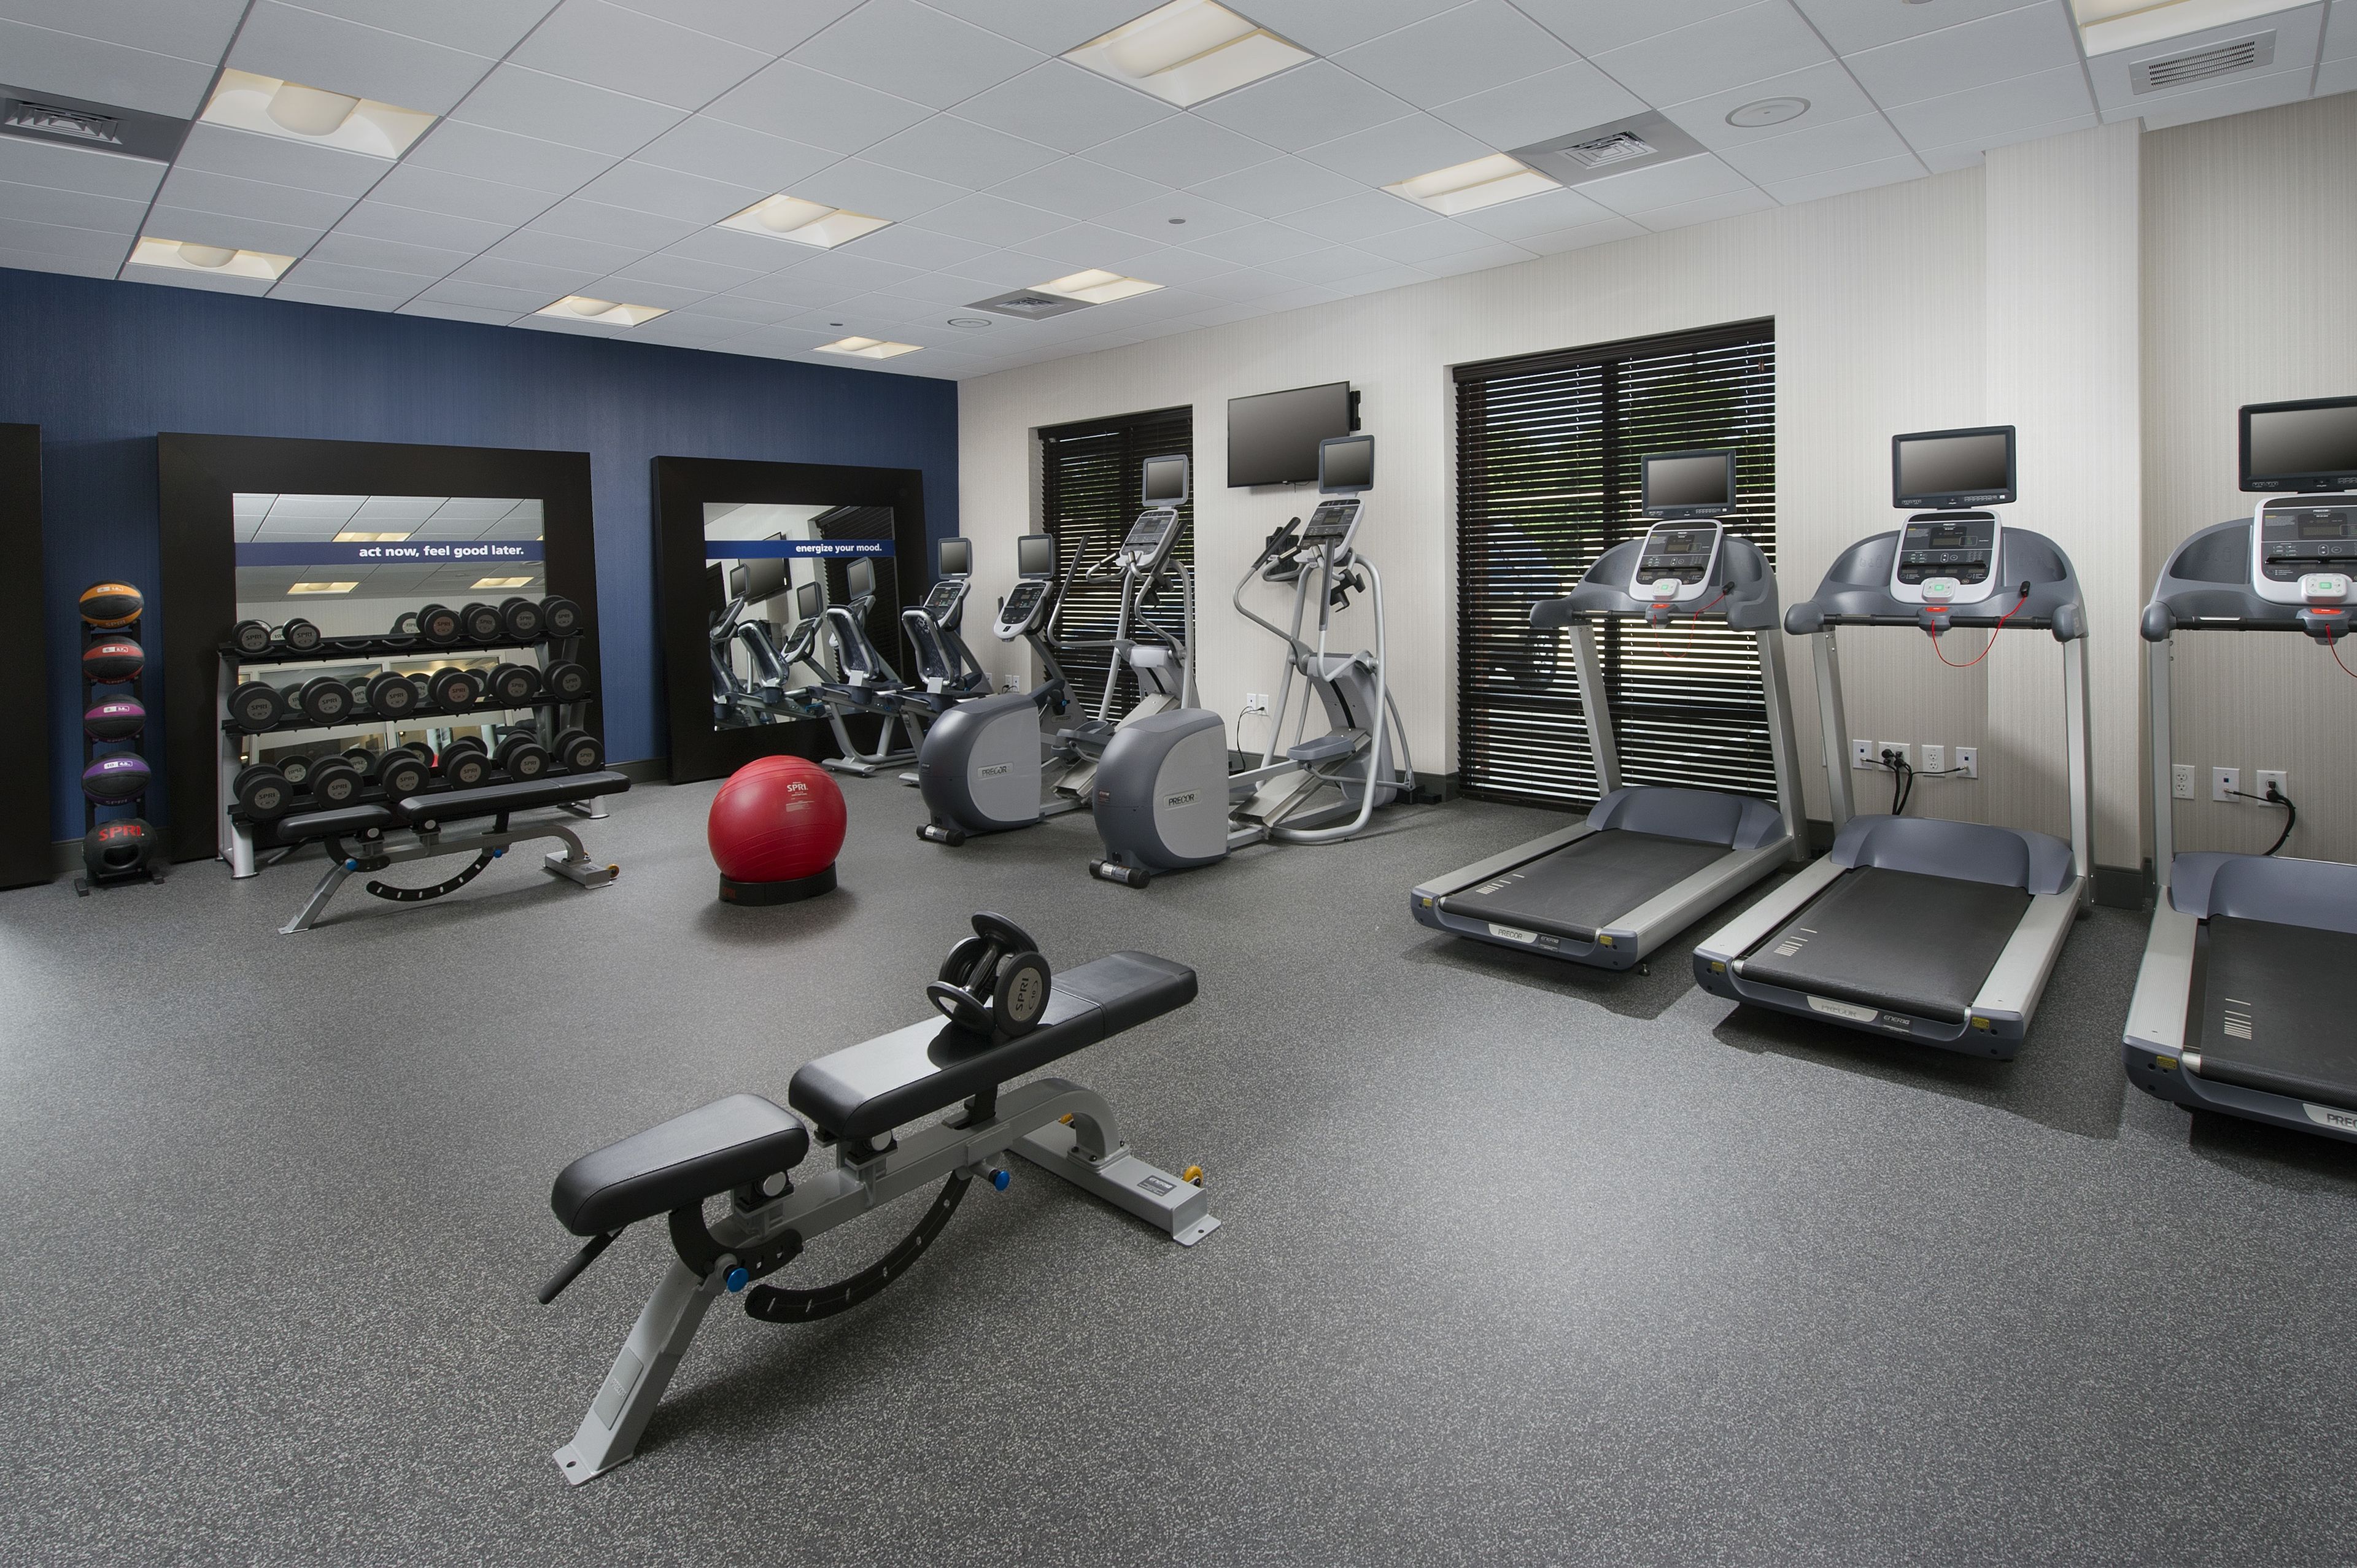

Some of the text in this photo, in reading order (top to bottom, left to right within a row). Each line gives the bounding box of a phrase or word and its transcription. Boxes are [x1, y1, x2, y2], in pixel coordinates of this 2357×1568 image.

[359, 545, 524, 558] act now, feel good later.
[795, 544, 833, 554] energize
[835, 545, 854, 554] your
[982, 766, 1007, 776] PRECOR
[786, 784, 807, 792] SPRI
[1168, 794, 1194, 806] PRECOR
[98, 825, 142, 841] SPRI
[1498, 929, 1523, 940] PRECOR
[1015, 978, 1029, 1011] SPRI
[1031, 990, 1036, 998] 10
